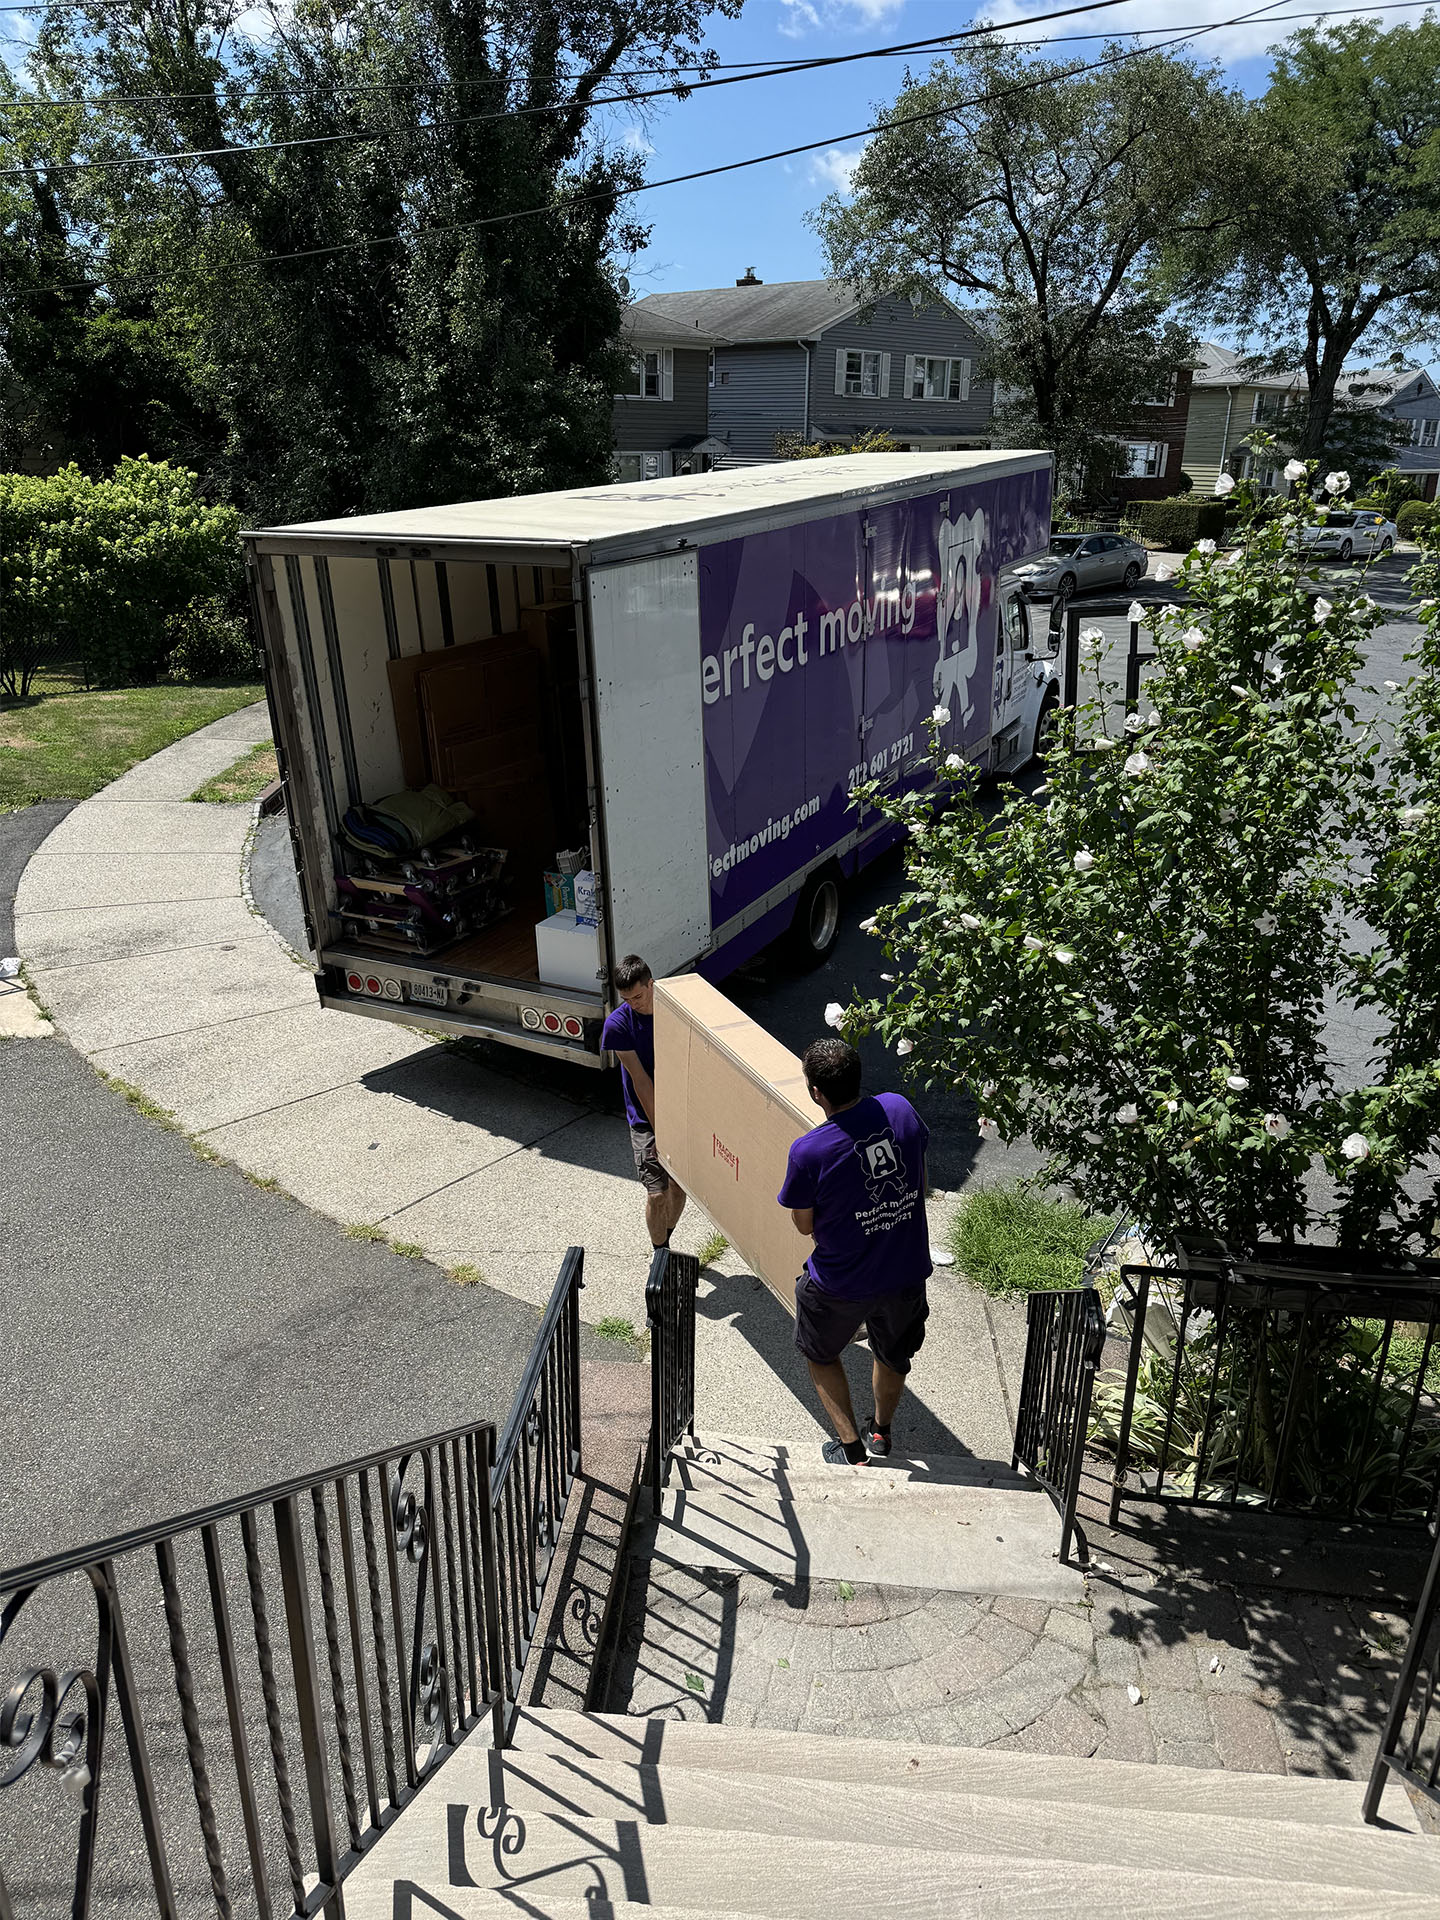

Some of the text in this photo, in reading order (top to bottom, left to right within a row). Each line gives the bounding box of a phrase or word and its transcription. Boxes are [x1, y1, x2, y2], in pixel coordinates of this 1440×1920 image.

[819, 577, 916, 656] moving
[848, 731, 914, 791] 212 601 2721
[716, 1138, 735, 1164] FRAGILE
[855, 1189, 919, 1220] perfect moving
[864, 1211, 912, 1235] 212-6012721
